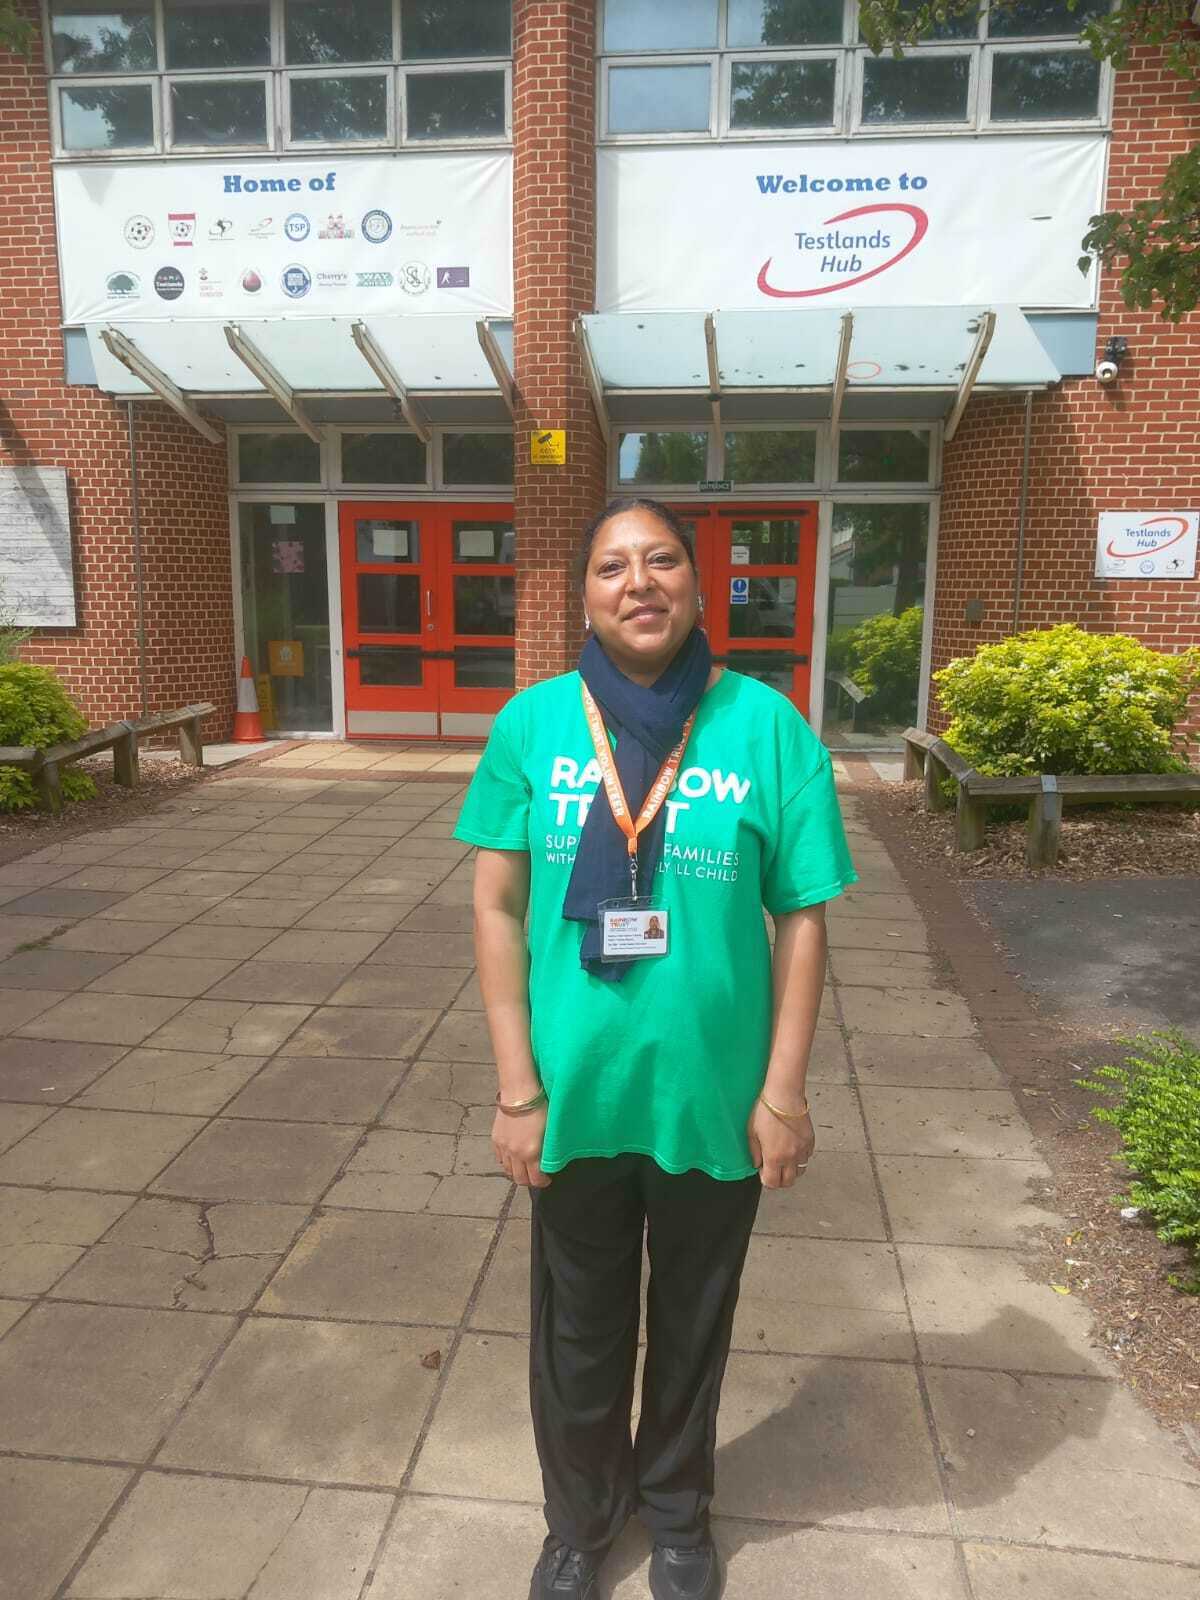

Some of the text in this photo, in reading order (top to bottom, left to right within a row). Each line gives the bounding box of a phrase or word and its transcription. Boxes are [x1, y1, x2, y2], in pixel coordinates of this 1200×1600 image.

[223, 172, 337, 193] Home of
[756, 172, 928, 194] Welcome to
[289, 223, 306, 233] TSP
[794, 230, 891, 250] Testlands
[820, 253, 862, 273] Hub
[1125, 528, 1171, 537] Testlands
[1136, 538, 1158, 548] Hub
[550, 755, 751, 804] RAOW
[664, 843, 740, 866] FAMILIES
[695, 866, 738, 882] CHILD
